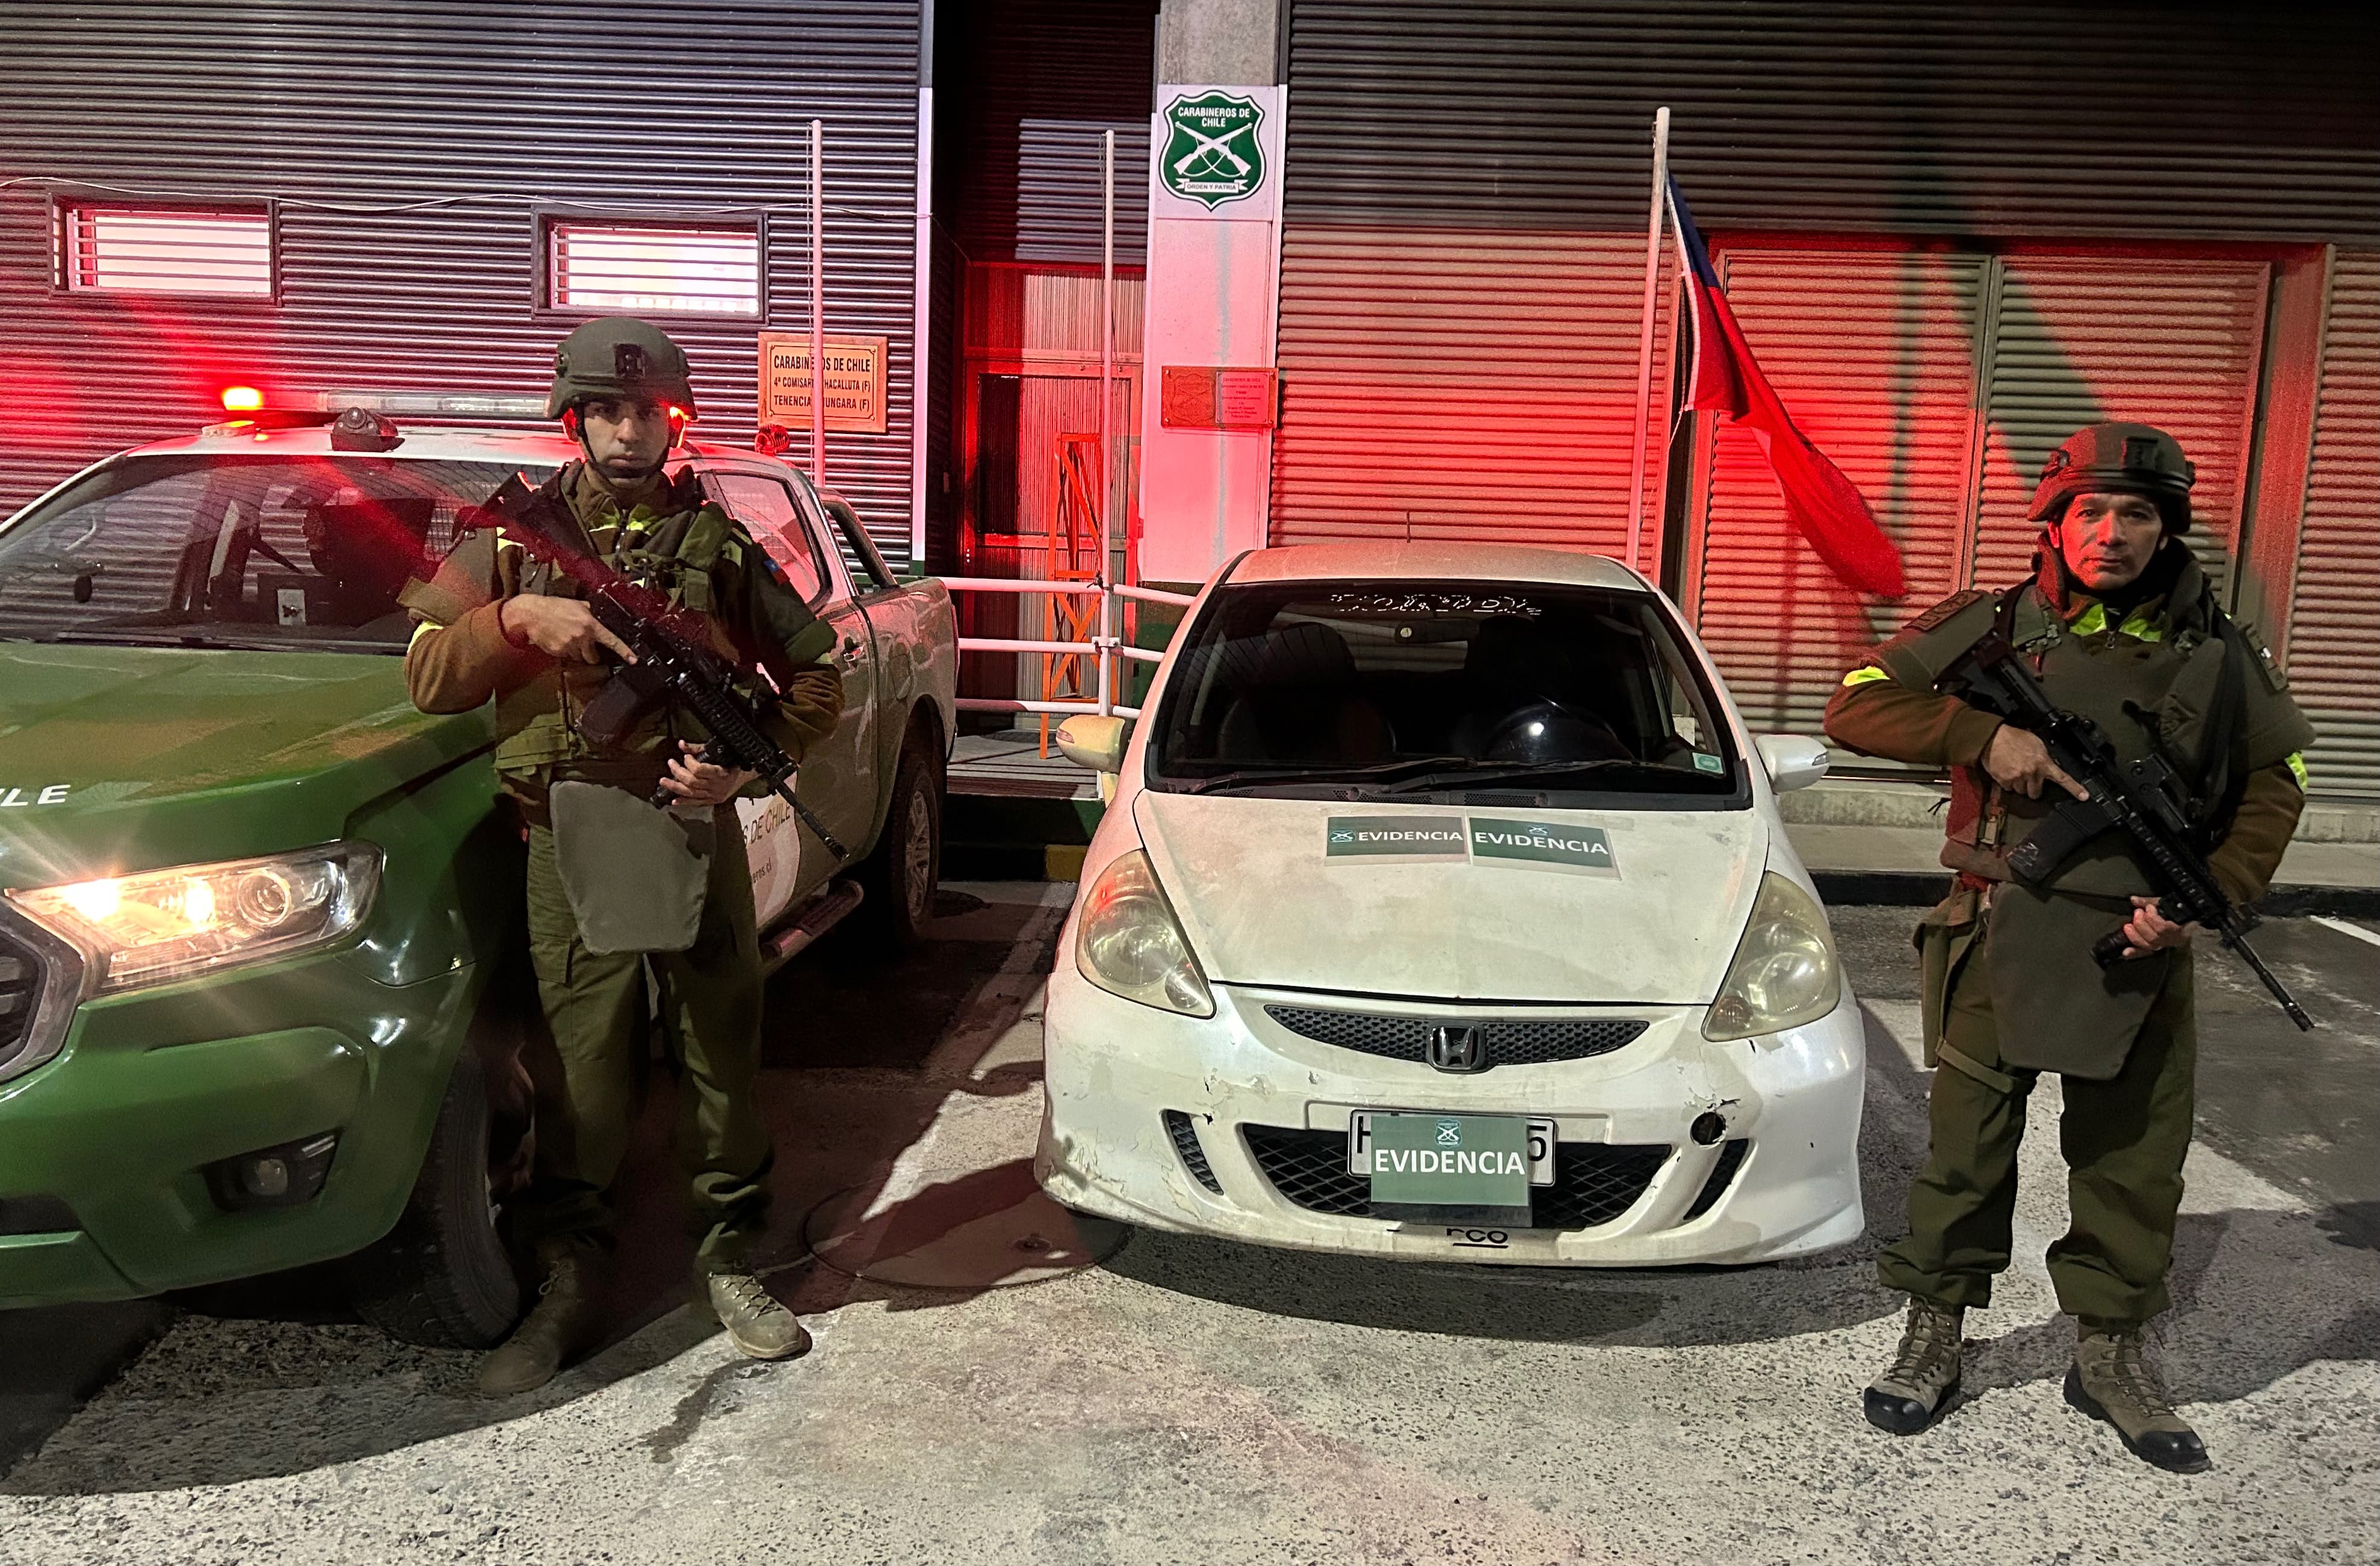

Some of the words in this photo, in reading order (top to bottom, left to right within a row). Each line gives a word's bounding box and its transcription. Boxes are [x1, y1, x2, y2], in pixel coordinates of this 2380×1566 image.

[1178, 107, 1237, 117] CARABINEROS
[1239, 108, 1250, 118] DE
[1201, 118, 1226, 127] CHILE
[774, 355, 831, 371] CARABINEOS
[833, 357, 844, 371] DE
[846, 358, 870, 373] CHILE
[824, 379, 860, 391] HACALLUTA
[862, 380, 871, 392] (F)
[774, 395, 812, 407] TENENCIA
[823, 397, 857, 409] UNGARA
[859, 399, 870, 412] (F)
[0, 784, 71, 807] LE
[750, 814, 764, 844] DE
[1358, 831, 1464, 841] EVIDENCIA
[1474, 831, 1609, 855] EVIDENCIA
[1375, 1149, 1525, 1175] EVIDENCIA
